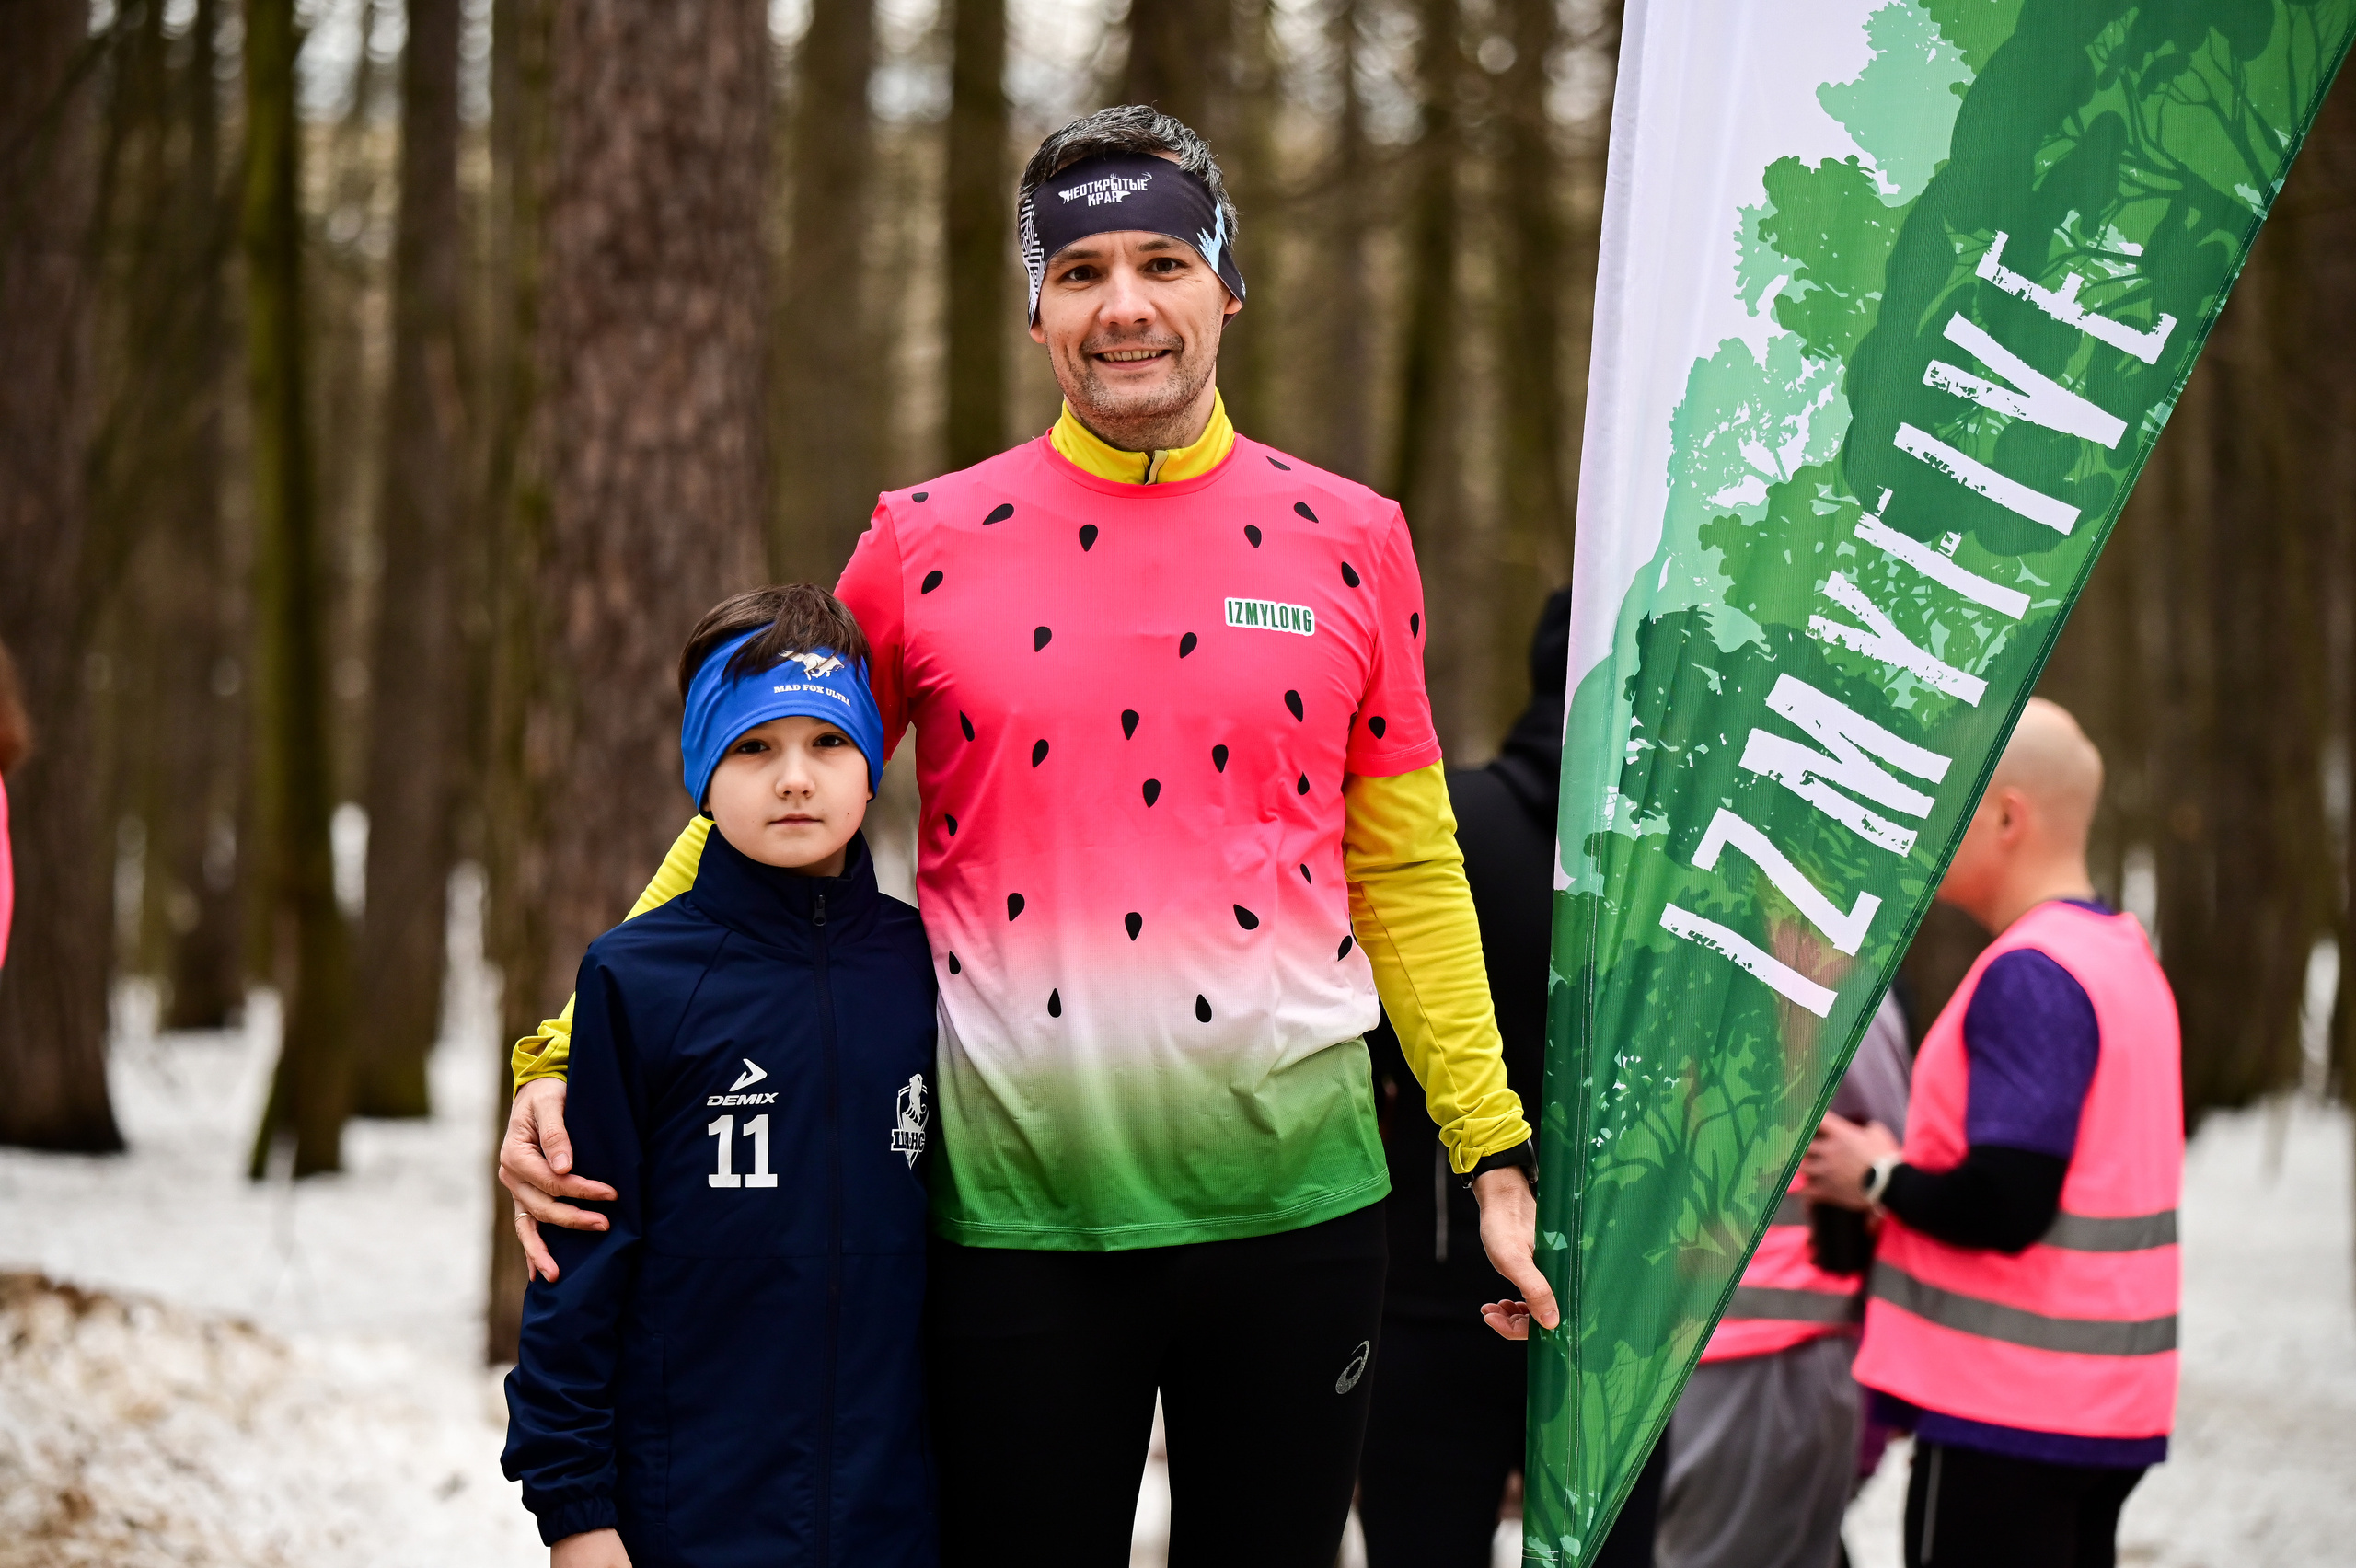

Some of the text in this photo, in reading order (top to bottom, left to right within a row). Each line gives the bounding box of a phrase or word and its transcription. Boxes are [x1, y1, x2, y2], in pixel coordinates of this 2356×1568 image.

[1064, 178, 1149, 201] НЕОТКРЫТЫЕ
[1087, 190, 1124, 206] КРАЯ
[1228, 600, 1312, 632] IZMYLONG
[1660, 229, 2177, 1019] IZMYFIVE
[774, 684, 850, 707] MAD FOX ULTRA
[707, 1092, 779, 1106] DEMIX
[708, 1114, 778, 1188] 11
